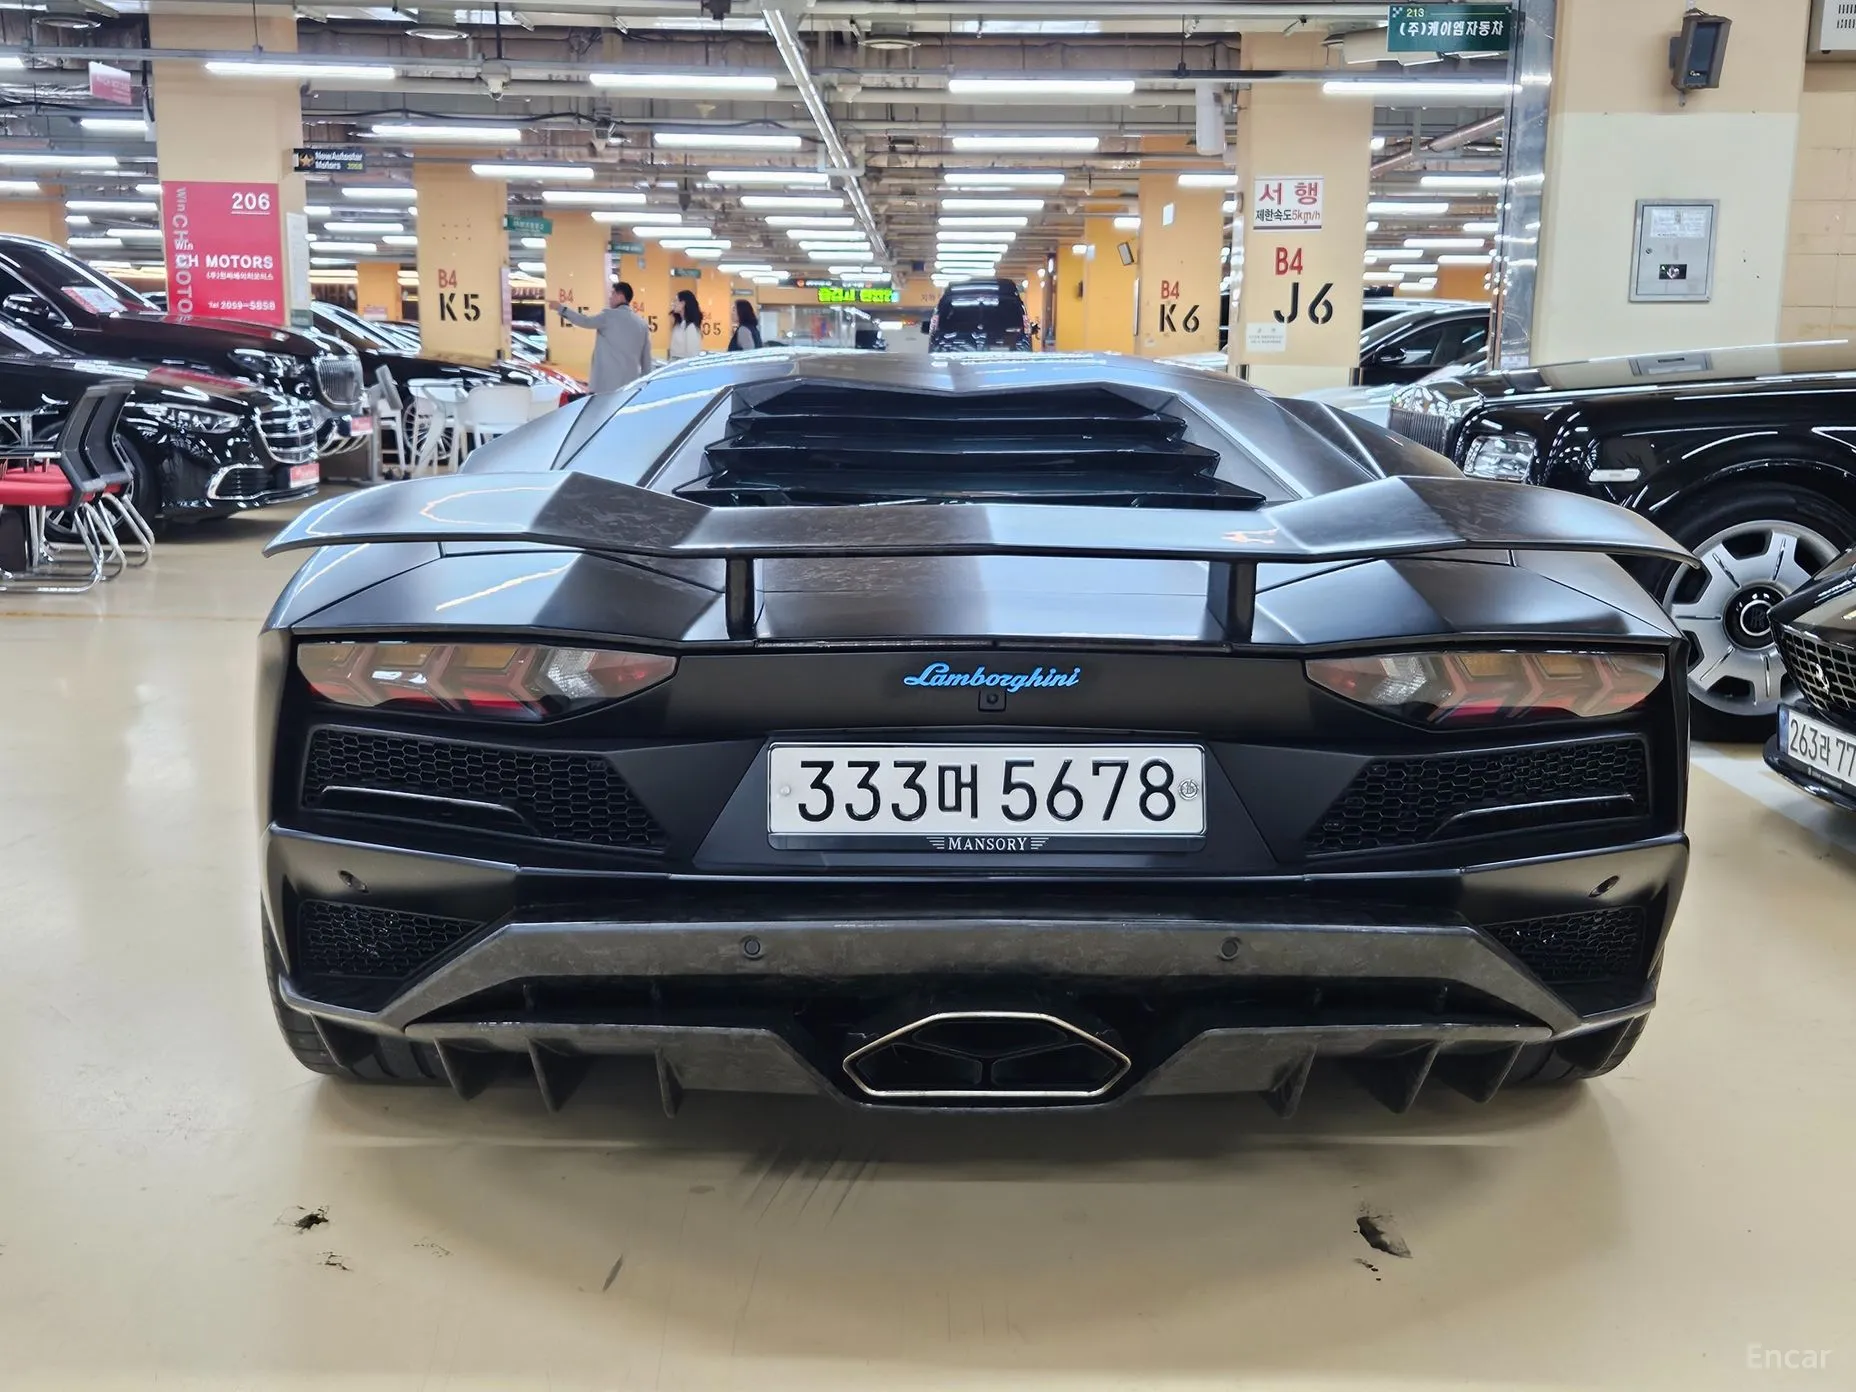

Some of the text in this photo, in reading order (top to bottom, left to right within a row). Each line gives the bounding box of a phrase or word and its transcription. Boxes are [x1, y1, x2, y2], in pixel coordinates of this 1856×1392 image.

[1406, 8, 1425, 17] 213
[1400, 20, 1504, 36] (주)케이엠자동차
[231, 191, 271, 210] 206
[175, 254, 274, 270] CH MOTORS
[1275, 247, 1303, 275] B4
[438, 269, 458, 288] B4
[559, 288, 574, 303] B4
[1161, 280, 1180, 299] B4
[439, 293, 481, 322] K5
[1273, 282, 1334, 324] J6
[1160, 304, 1200, 333] K6
[903, 661, 1081, 692] Lamborghini
[1789, 718, 1831, 767] 263라
[798, 758, 1176, 822] 333머 5678
[948, 835, 1028, 851] MANSORY
